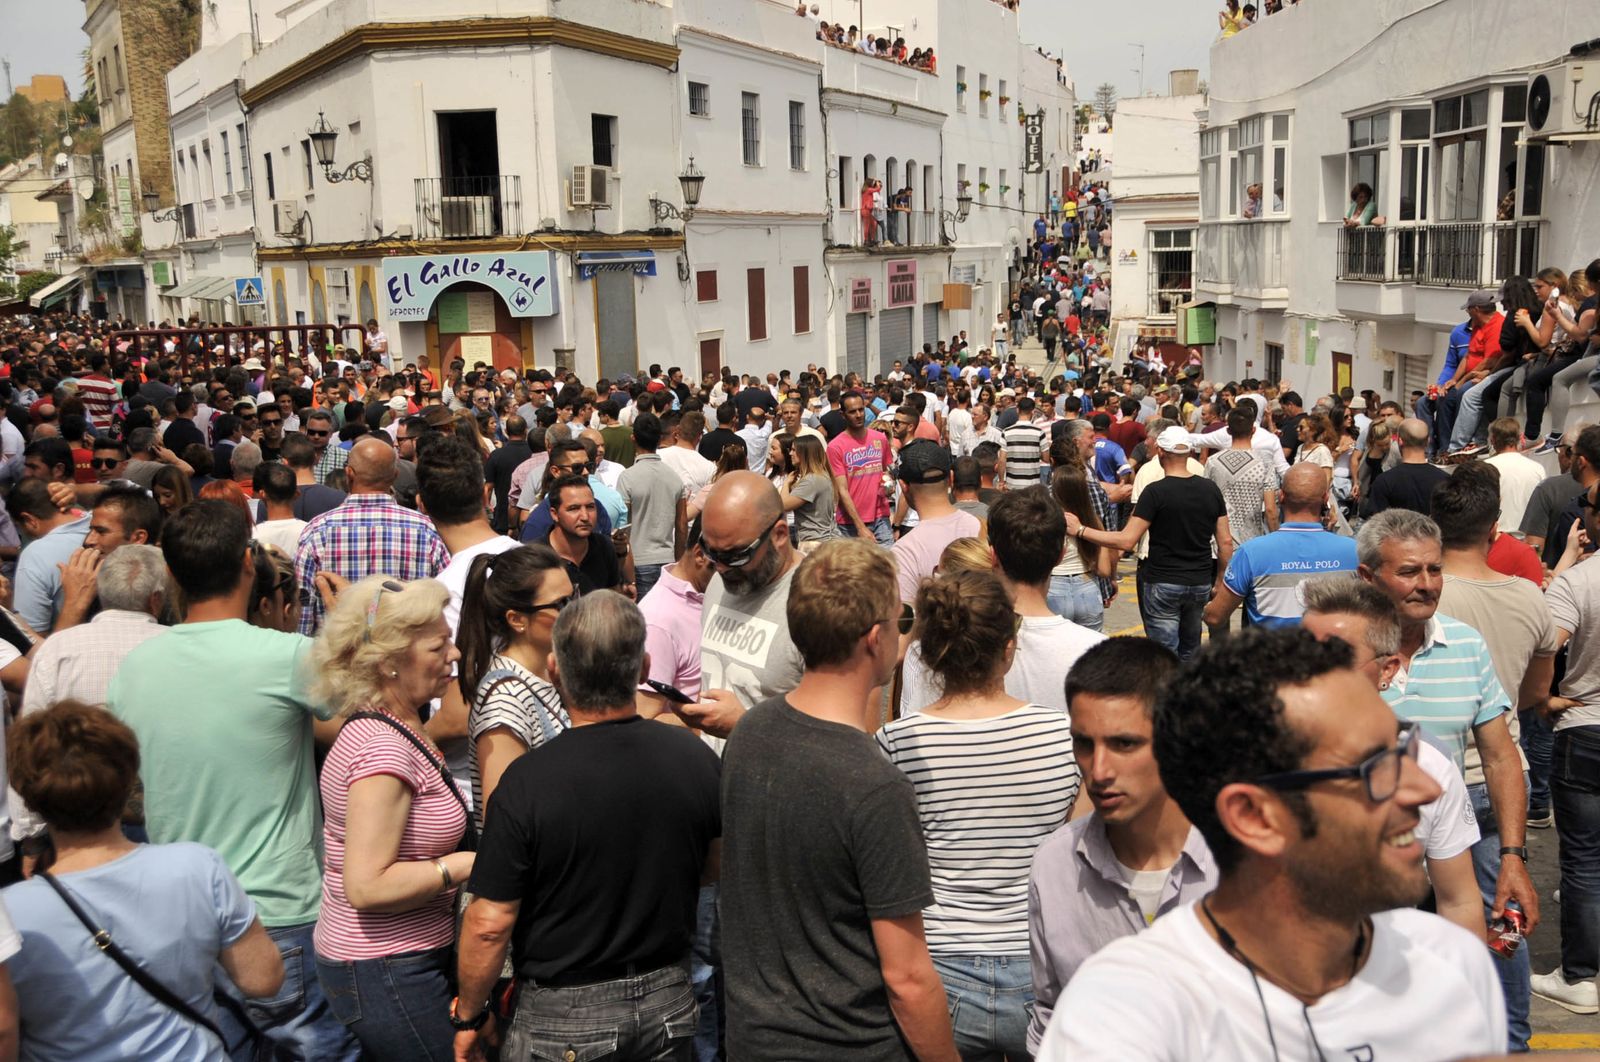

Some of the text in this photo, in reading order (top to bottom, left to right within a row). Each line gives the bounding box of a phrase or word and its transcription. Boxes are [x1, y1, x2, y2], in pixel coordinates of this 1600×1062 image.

[1027, 116, 1041, 162] HOTEL
[584, 265, 593, 277] EL
[626, 262, 649, 273] AZUL
[387, 258, 546, 304] El Gallo Azul
[891, 283, 914, 304] LAILA
[389, 307, 425, 317] DEPORTES
[1281, 560, 1340, 570] ROYAL POLO
[703, 614, 767, 656] NINGBO
